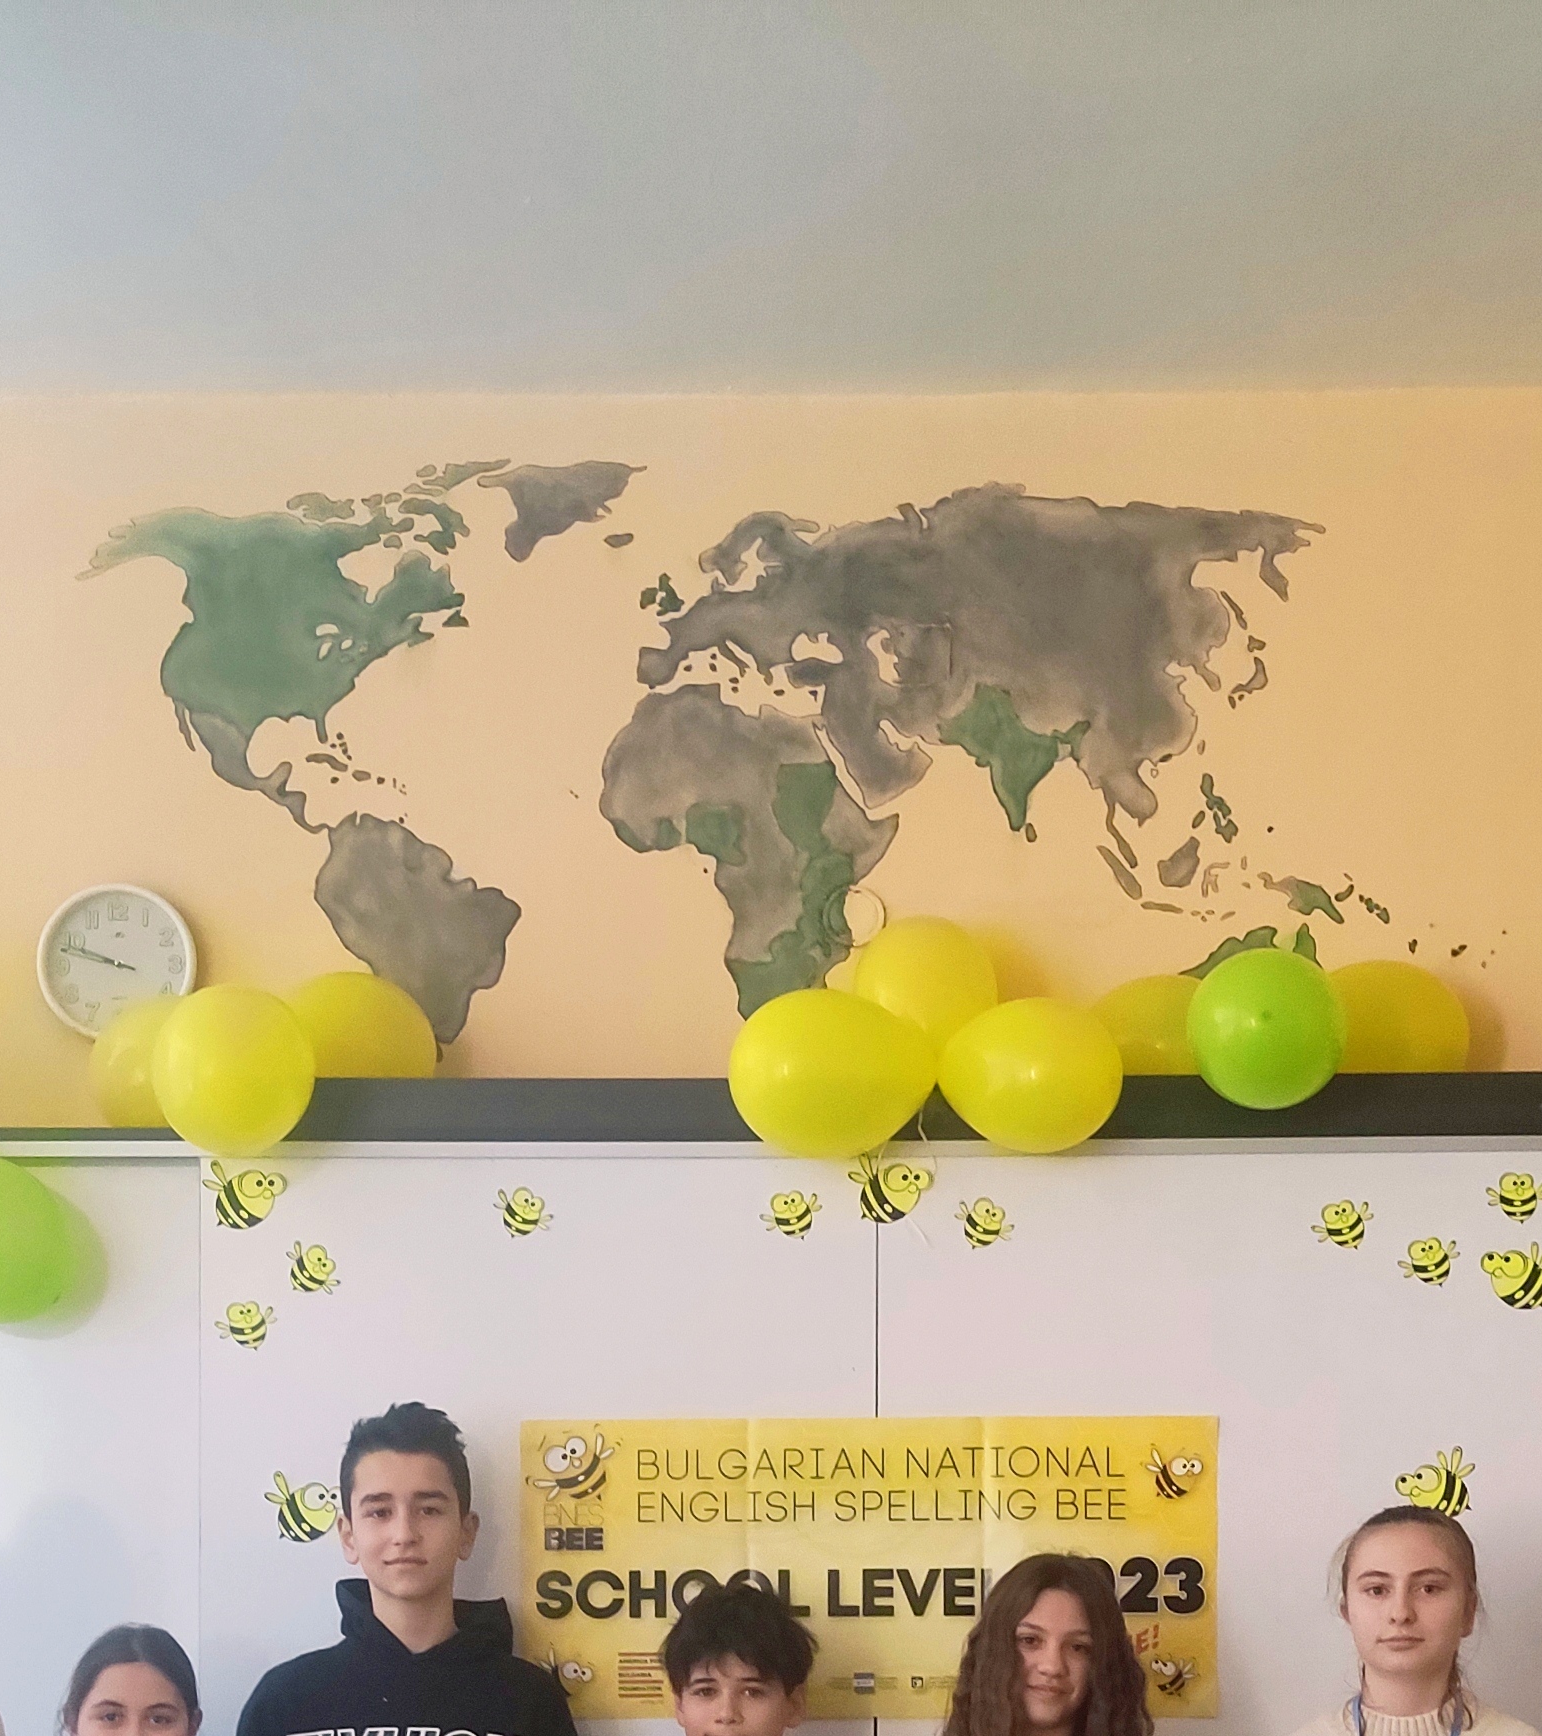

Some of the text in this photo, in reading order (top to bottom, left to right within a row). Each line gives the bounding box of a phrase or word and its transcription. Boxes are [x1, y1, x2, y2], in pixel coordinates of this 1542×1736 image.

[108, 902, 129, 921] 12
[159, 927, 174, 947] 2
[168, 954, 183, 974] 3
[85, 1002, 101, 1022] 7
[636, 1445, 1126, 1482] BULGARIAN NATIONAL
[543, 1502, 605, 1527] BNES
[636, 1488, 1127, 1523] ENGLISH SPELLING BEE
[544, 1527, 604, 1551] BEE
